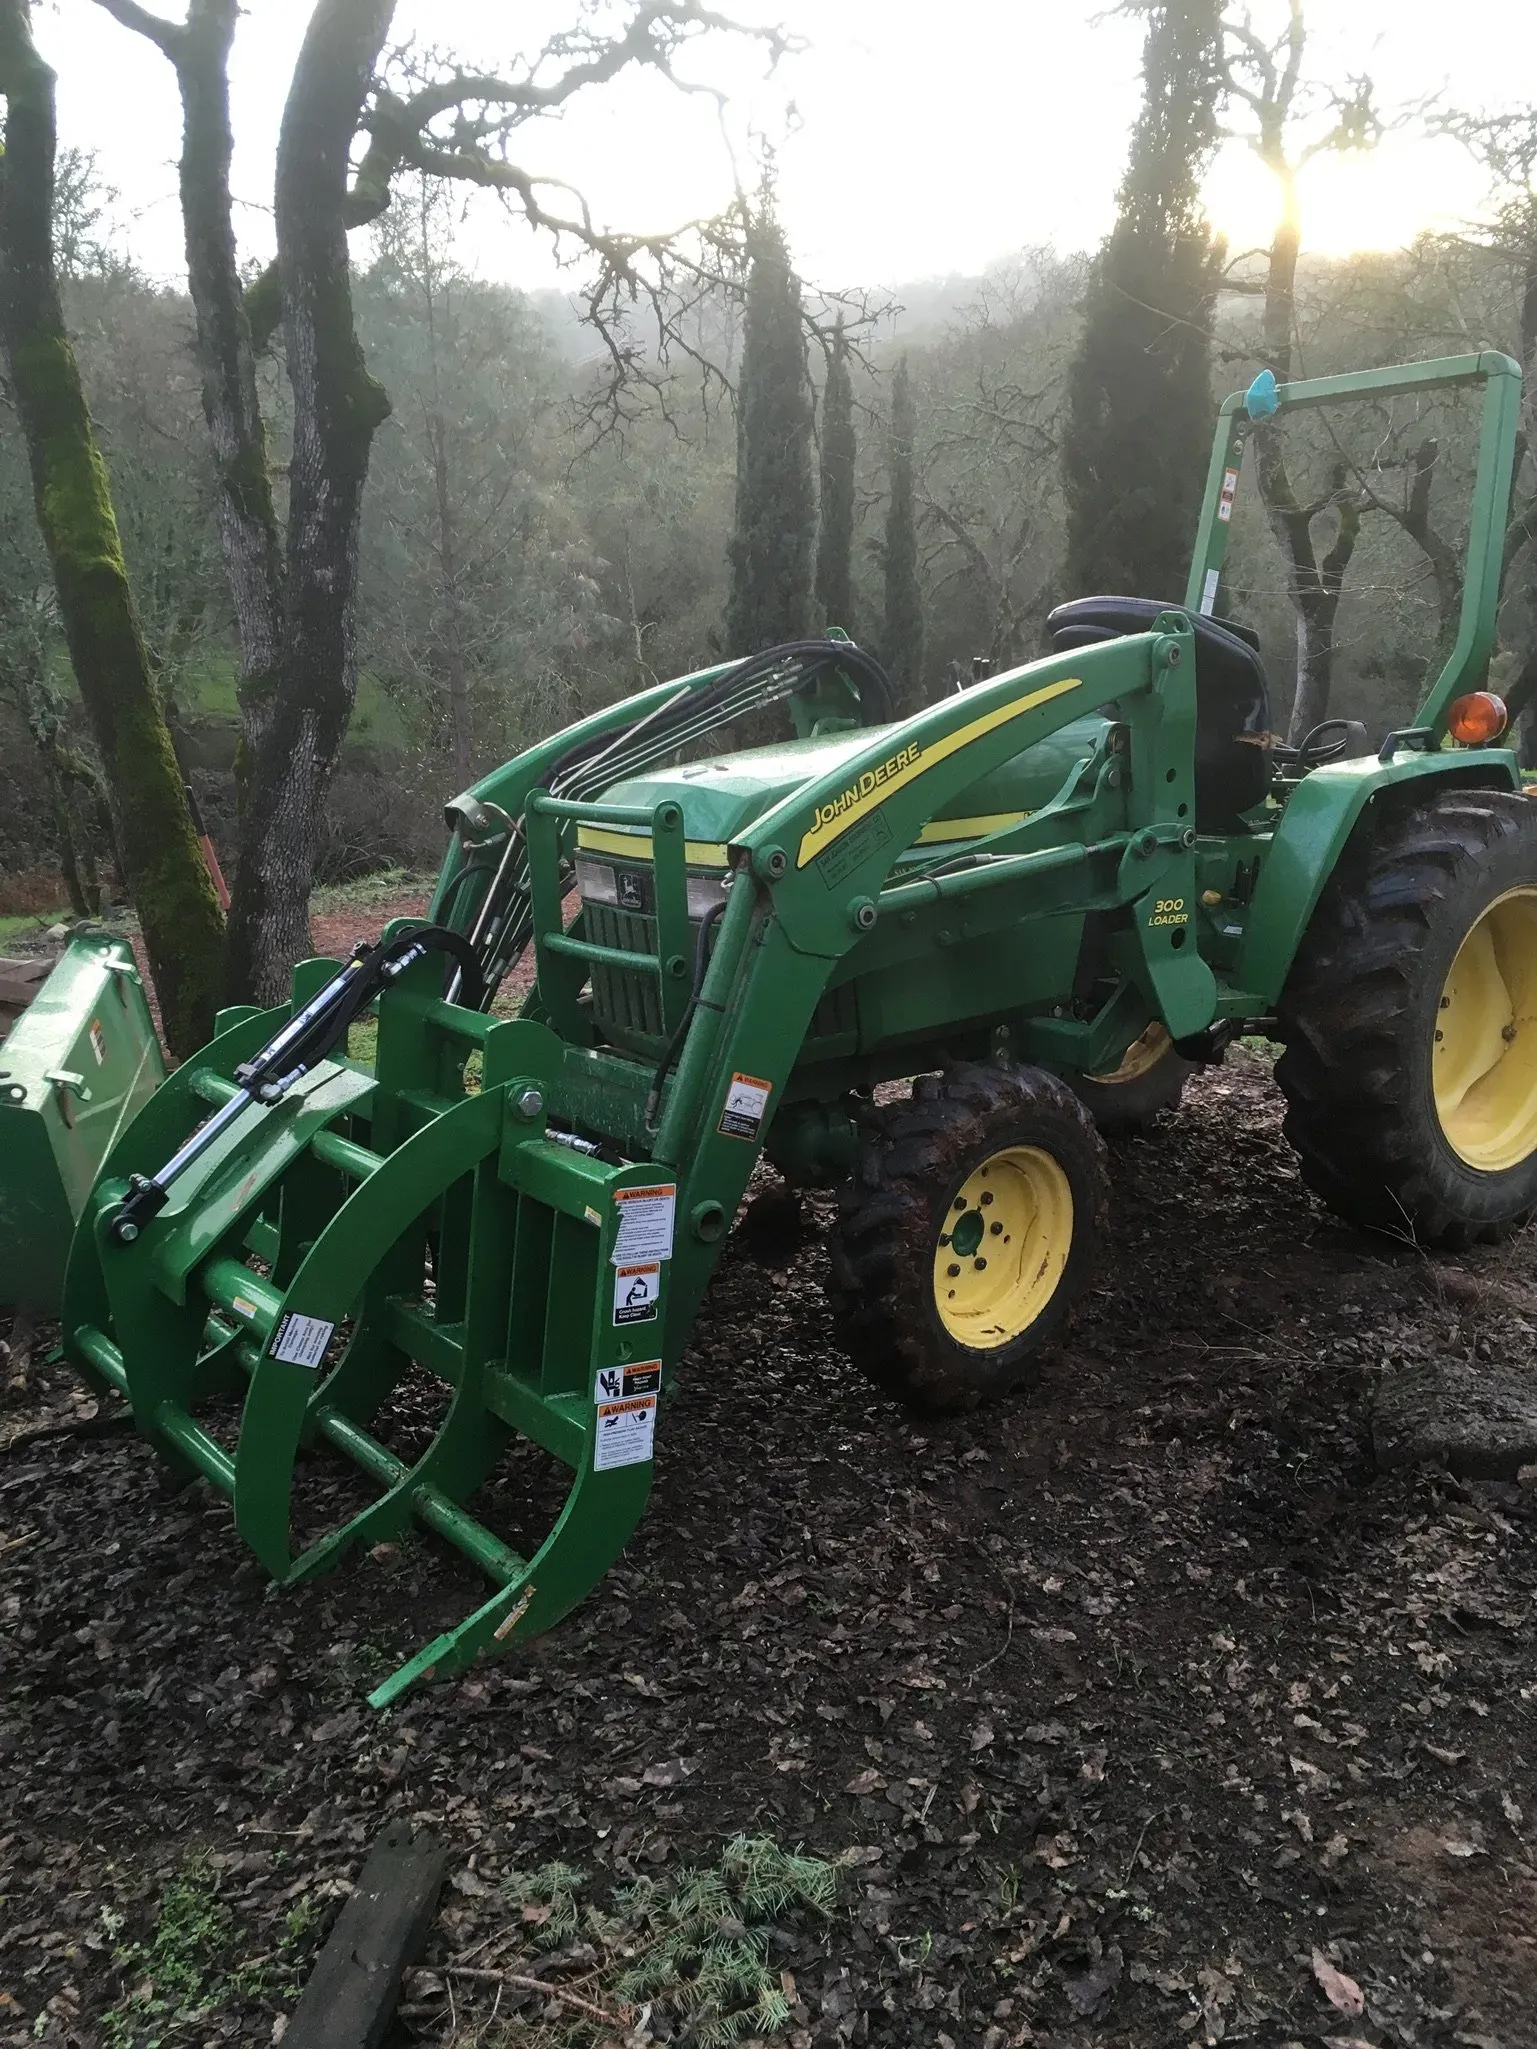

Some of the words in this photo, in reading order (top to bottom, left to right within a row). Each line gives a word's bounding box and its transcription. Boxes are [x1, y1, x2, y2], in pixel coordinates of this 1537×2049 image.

[810, 785, 860, 833] JOHN
[859, 741, 921, 799] DEERE
[1154, 898, 1184, 913] 300
[1148, 913, 1189, 927] LOADER
[630, 1189, 662, 1198] WARNING
[627, 1265, 656, 1274] WARNING
[269, 1314, 291, 1355] IMPORTANT
[631, 1364, 658, 1373] WARNING
[611, 1400, 651, 1413] WARNING
